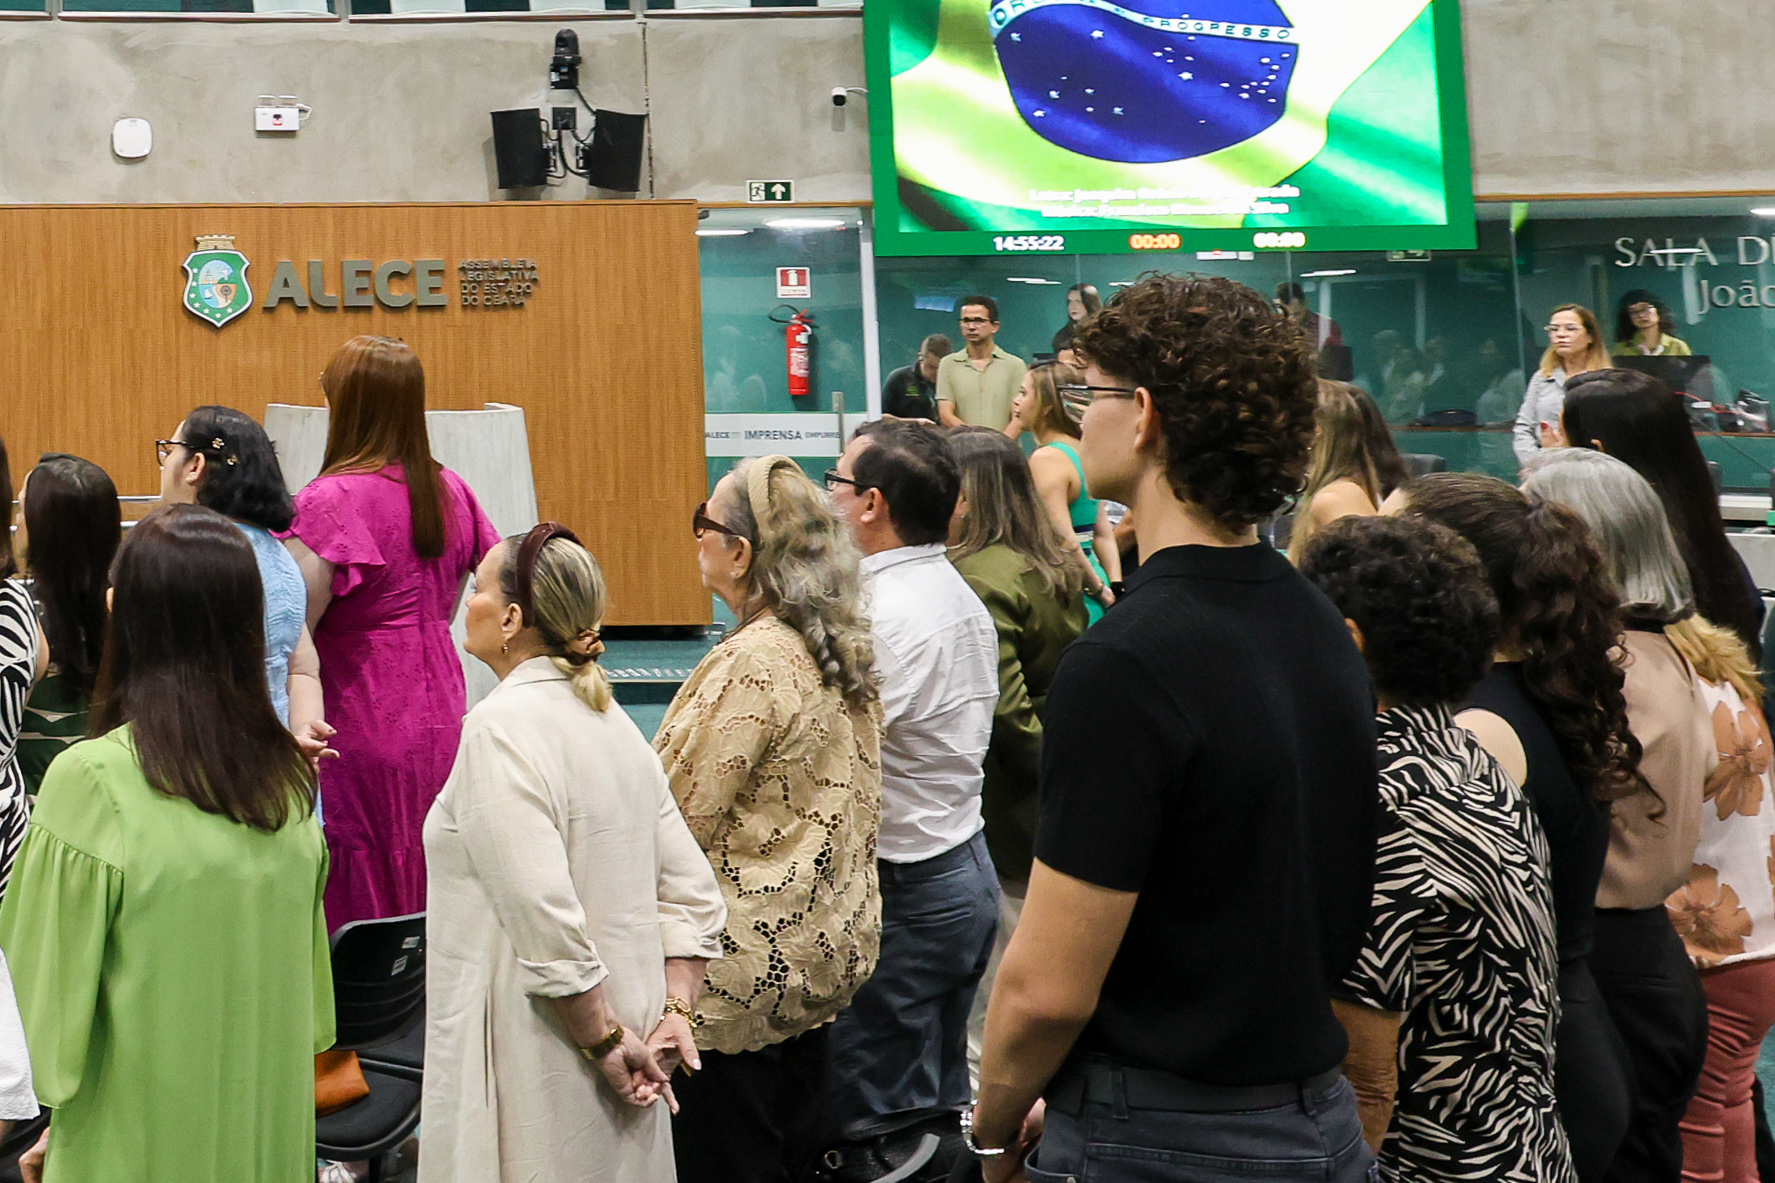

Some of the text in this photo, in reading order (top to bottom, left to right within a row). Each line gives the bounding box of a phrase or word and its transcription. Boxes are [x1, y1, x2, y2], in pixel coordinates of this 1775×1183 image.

[1143, 17, 1290, 39] PROGRESSO
[1615, 234, 1775, 267] SALA D
[263, 259, 450, 308] ALECE
[461, 283, 479, 293] DO
[462, 296, 479, 306] DO
[744, 430, 803, 440] IMPRENSA
